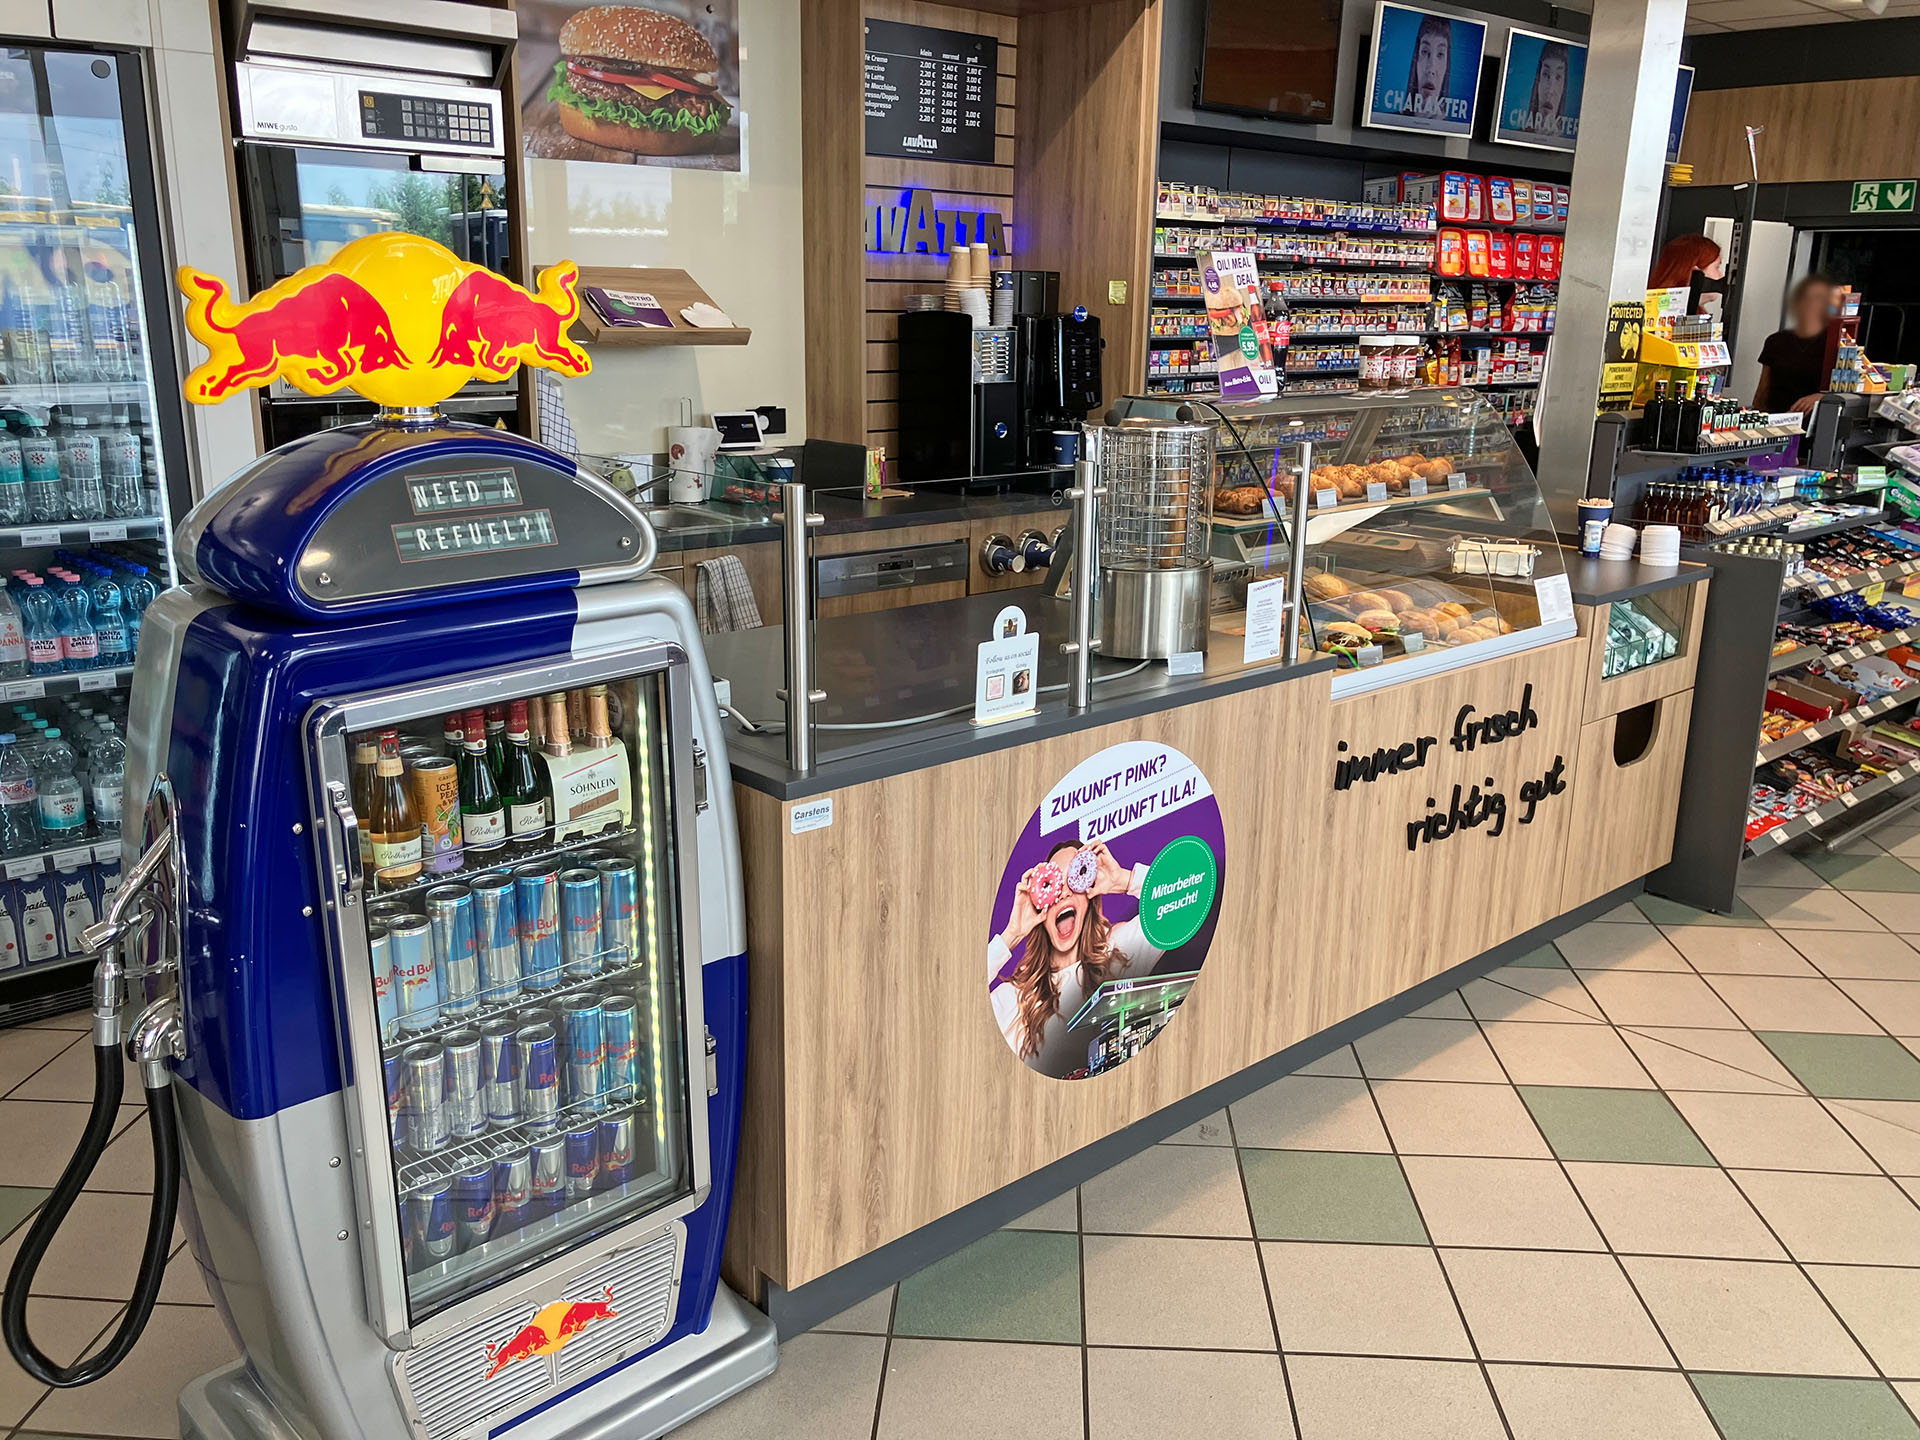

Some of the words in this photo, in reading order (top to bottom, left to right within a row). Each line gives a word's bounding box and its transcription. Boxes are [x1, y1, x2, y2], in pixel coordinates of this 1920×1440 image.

[1384, 89, 1468, 119] CHARAKTER
[257, 121, 278, 130] MIWE
[279, 123, 298, 132] gusto
[903, 134, 937, 149] LAVAZZA
[1534, 191, 1550, 201] West
[1217, 260, 1230, 271] OIL!
[1232, 256, 1252, 270] MEAL
[1236, 274, 1255, 286] DEAL
[1611, 307, 1643, 318] PROTECTED
[1609, 321, 1619, 332] BY
[1259, 374, 1272, 386] OIL!
[412, 480, 480, 508] NEED
[502, 477, 516, 500] A
[1334, 736, 1437, 790] immer
[1450, 683, 1538, 752] frisch
[0, 784, 26, 793] evian
[436, 782, 451, 792] ICE
[570, 778, 616, 796] SÖHNLEIN
[1051, 772, 1122, 818] ZUKUNFT
[1125, 754, 1167, 786] PINK?
[1087, 794, 1158, 840] ZUKUNFT
[1161, 777, 1196, 808] LILA!
[1407, 776, 1506, 850] richtig
[1518, 755, 1566, 824] gut
[794, 806, 830, 820] Carstens
[1151, 872, 1206, 900] Mitarbeiter
[1156, 890, 1198, 920] gesucht!
[392, 964, 416, 978] Red
[1116, 982, 1133, 990] OIL!
